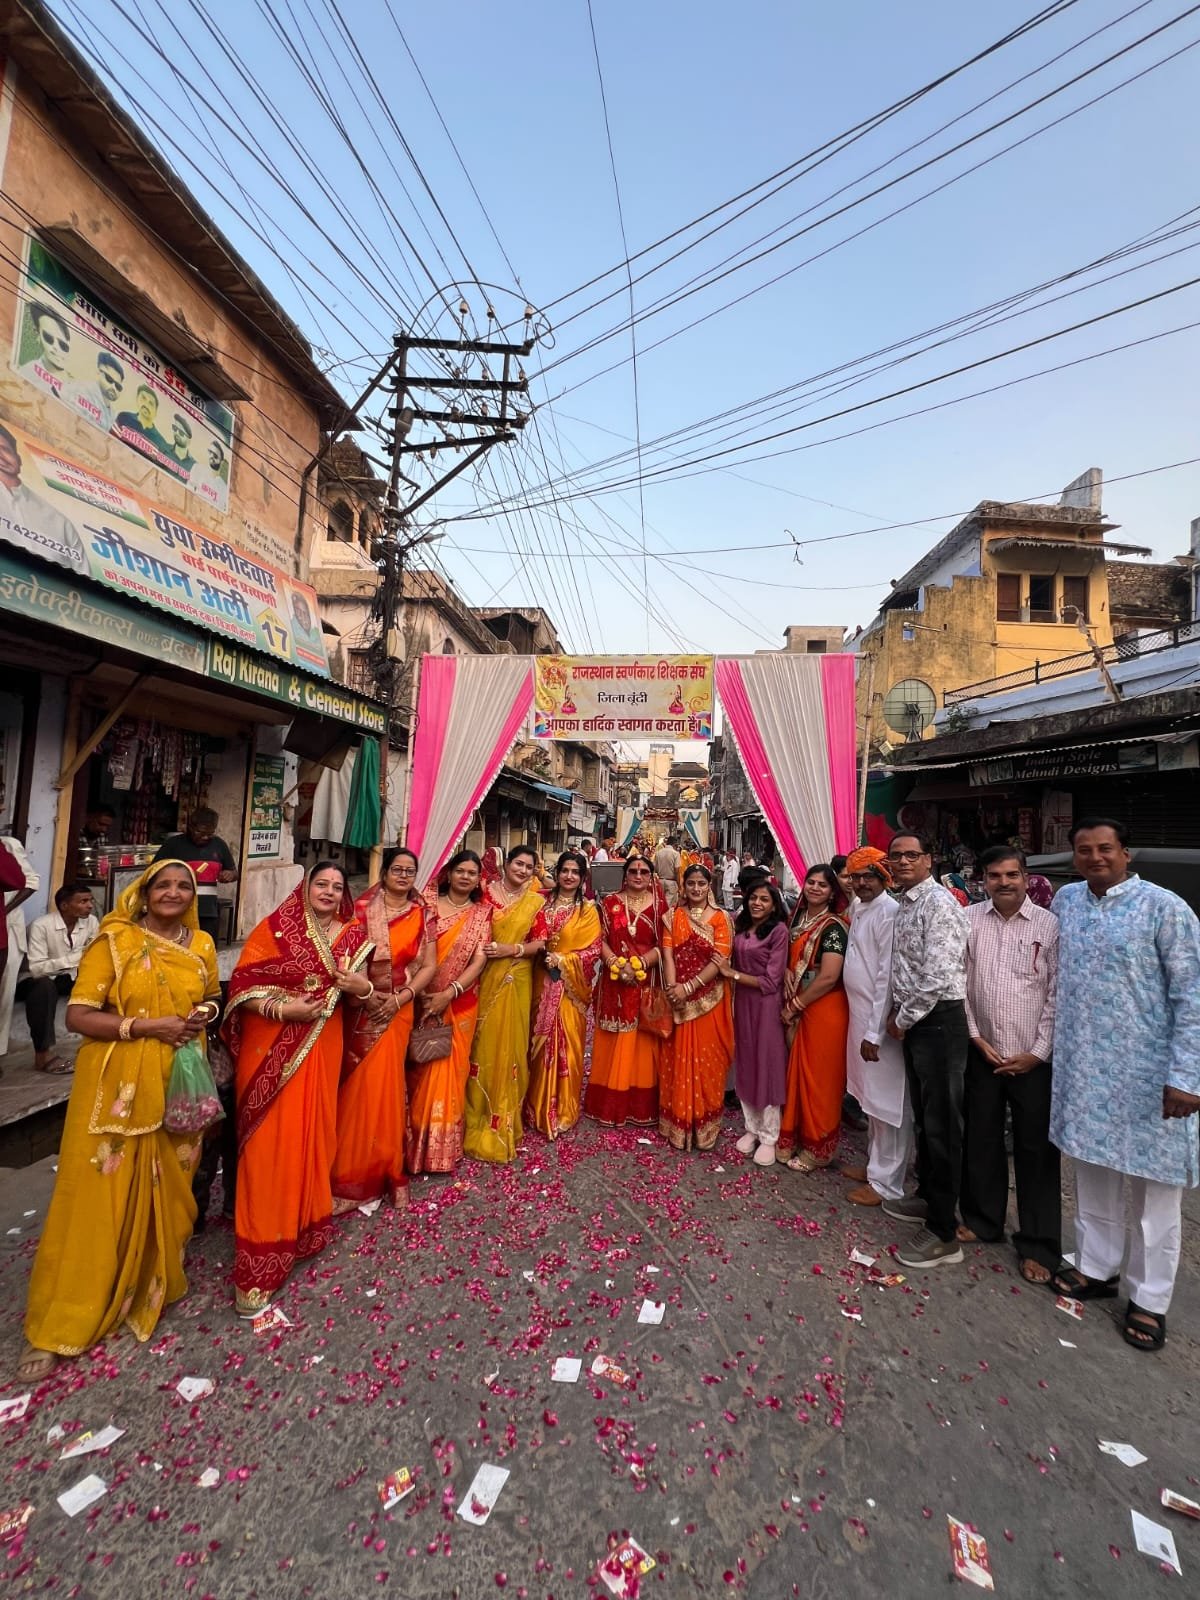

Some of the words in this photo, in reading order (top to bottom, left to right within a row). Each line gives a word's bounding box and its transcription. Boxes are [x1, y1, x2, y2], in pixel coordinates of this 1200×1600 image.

[74, 291, 109, 328] आप
[112, 324, 139, 355] सभी
[143, 351, 161, 373] को
[163, 366, 186, 395] ईद
[0, 516, 81, 561] 742222213
[150, 508, 196, 549] युवा
[195, 532, 277, 594] उम्मीदवार
[83, 523, 194, 599] जीशान
[196, 578, 252, 626] अली
[261, 620, 288, 653] 17
[213, 642, 237, 682] Raj
[238, 649, 280, 694] Kirana
[288, 674, 301, 703] &
[304, 681, 356, 722] General
[358, 700, 385, 731] Store
[572, 665, 613, 680] राजस्थान
[615, 660, 655, 681] स्वर्णकार
[656, 660, 688, 681] शिक्षक
[690, 661, 707, 680] संघ
[597, 691, 625, 703] जिला
[626, 691, 648, 706] बूंदी
[544, 717, 580, 732] आपका
[582, 713, 615, 732] हार्दिक
[617, 717, 653, 732] स्वागत
[655, 718, 686, 732] करता
[1014, 767, 1060, 781] Mehndi
[1063, 762, 1118, 776] Designs
[1025, 755, 1065, 767] Indian
[1069, 750, 1101, 763] Style
